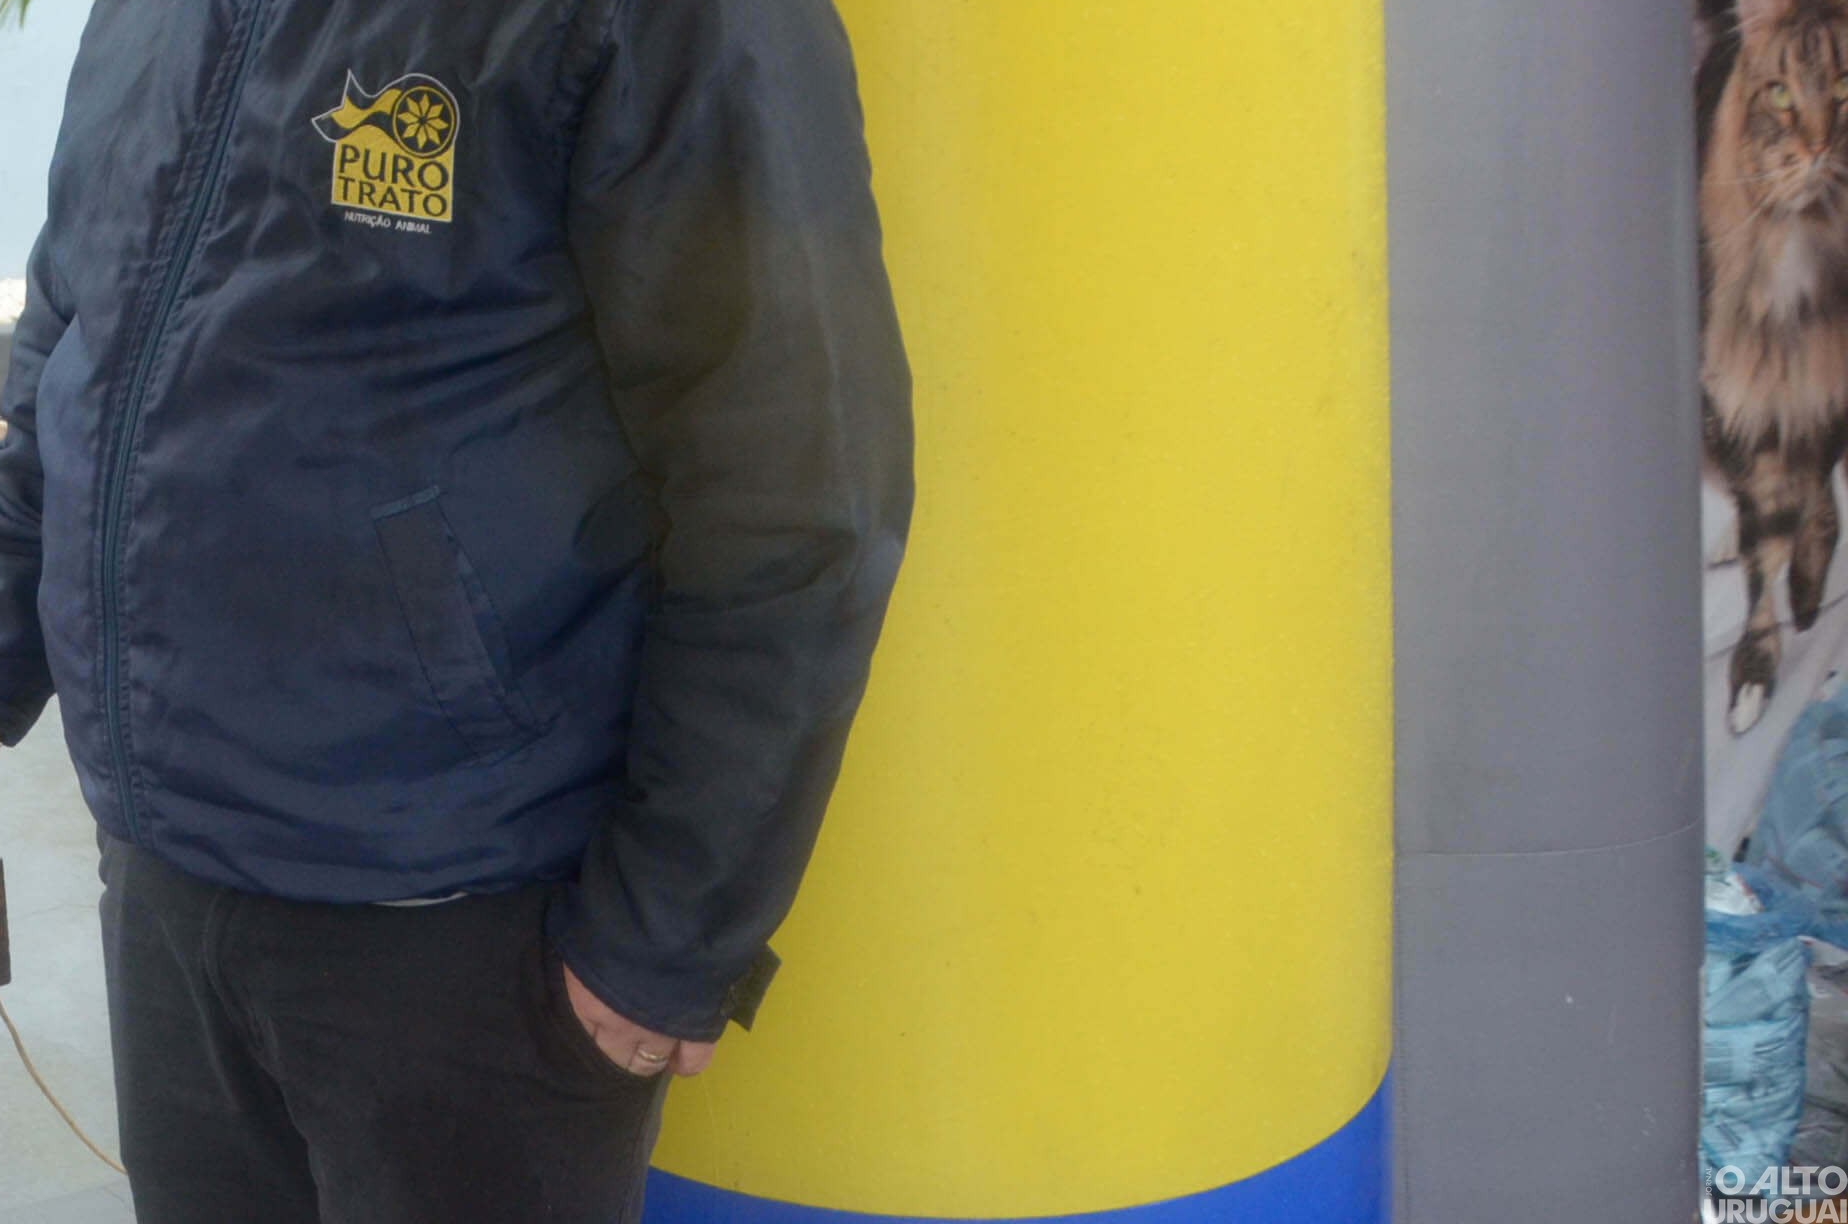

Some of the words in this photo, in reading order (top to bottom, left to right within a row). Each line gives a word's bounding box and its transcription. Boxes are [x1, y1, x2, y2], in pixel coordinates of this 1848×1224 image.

[338, 144, 449, 191] PURO
[338, 176, 448, 217] TRATO
[344, 210, 391, 229] NUTRIÇÃO
[395, 221, 432, 234] ANIMAL
